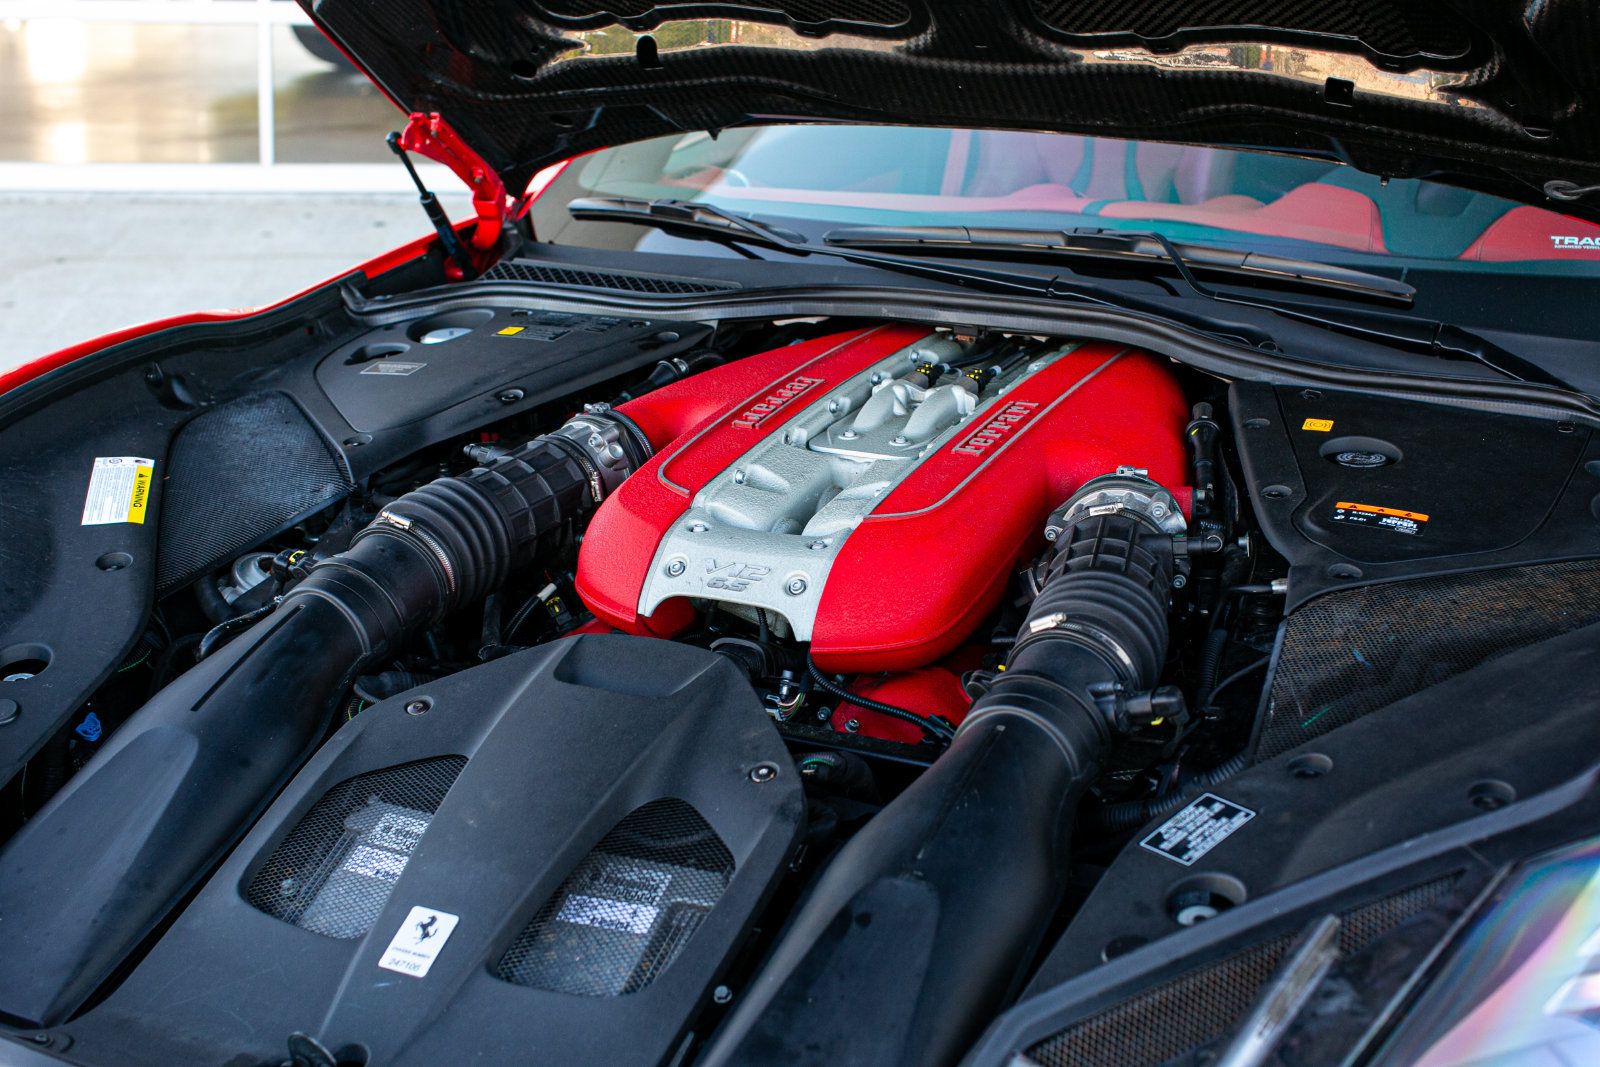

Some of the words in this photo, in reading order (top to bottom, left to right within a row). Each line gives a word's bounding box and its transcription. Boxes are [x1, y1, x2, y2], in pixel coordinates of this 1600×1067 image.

[731, 376, 825, 430] Ferrari
[951, 401, 1039, 457] Ferrari
[133, 480, 146, 508] WARNING
[704, 558, 771, 581] V12
[706, 576, 751, 592] 6.5
